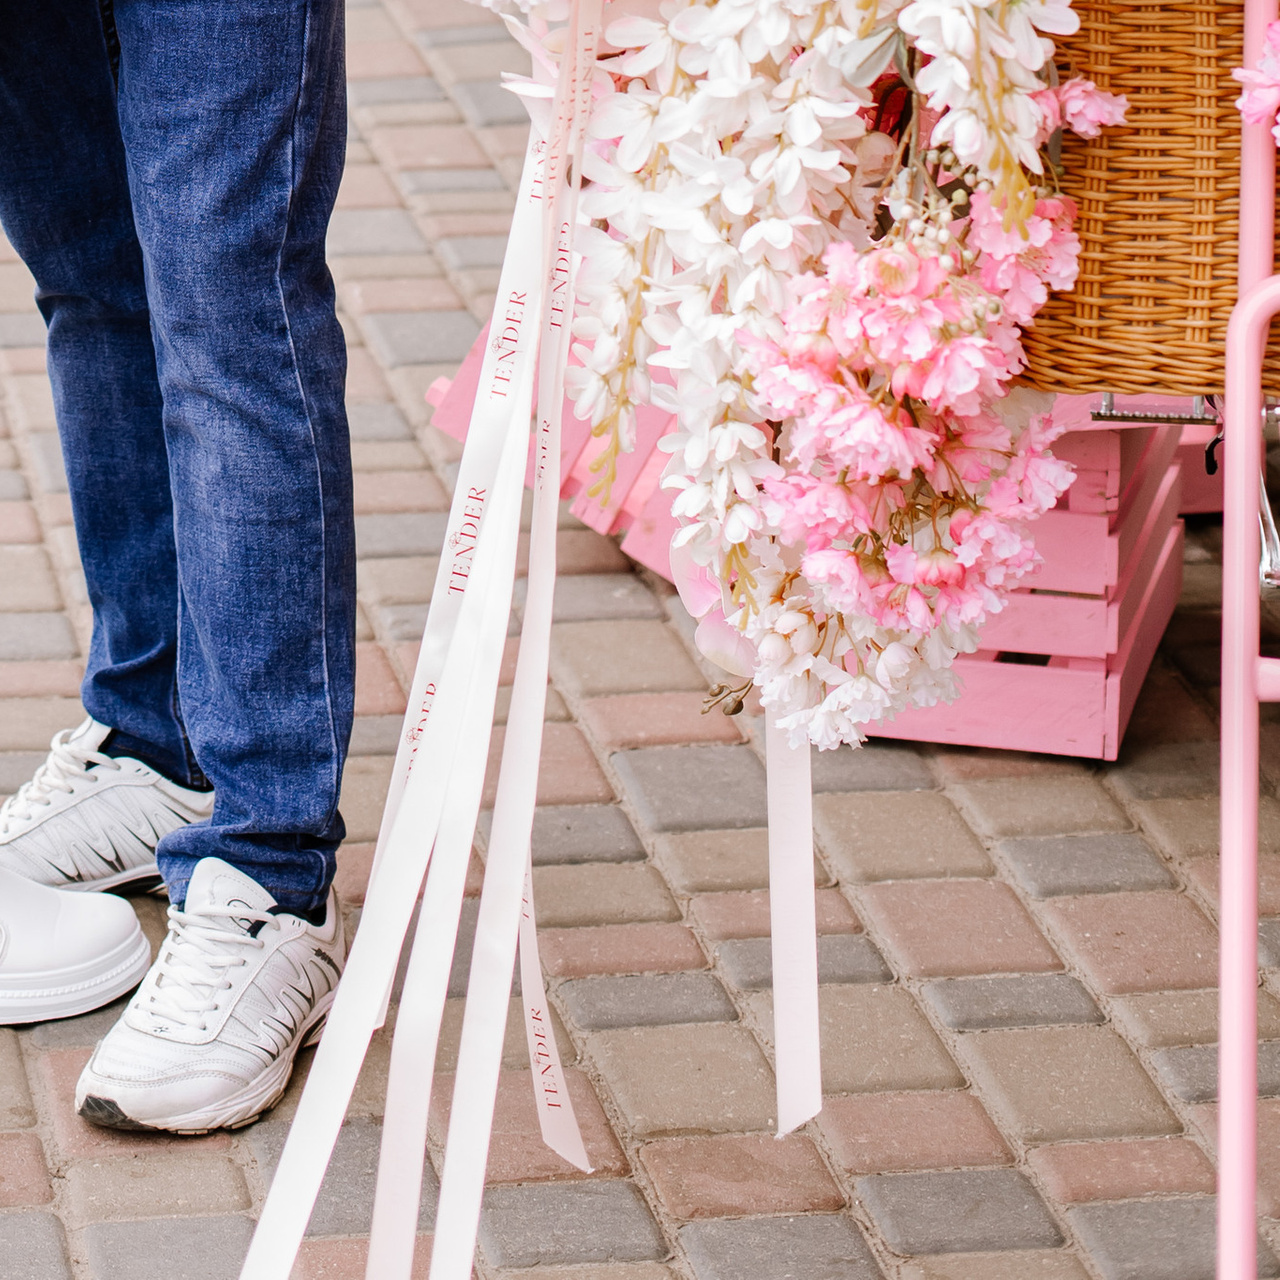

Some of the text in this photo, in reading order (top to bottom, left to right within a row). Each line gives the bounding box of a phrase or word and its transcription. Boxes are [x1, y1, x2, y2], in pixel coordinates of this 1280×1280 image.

[490, 291, 527, 400] TENDER
[448, 487, 487, 596] TENDER
[531, 1007, 562, 1110] TENDER
